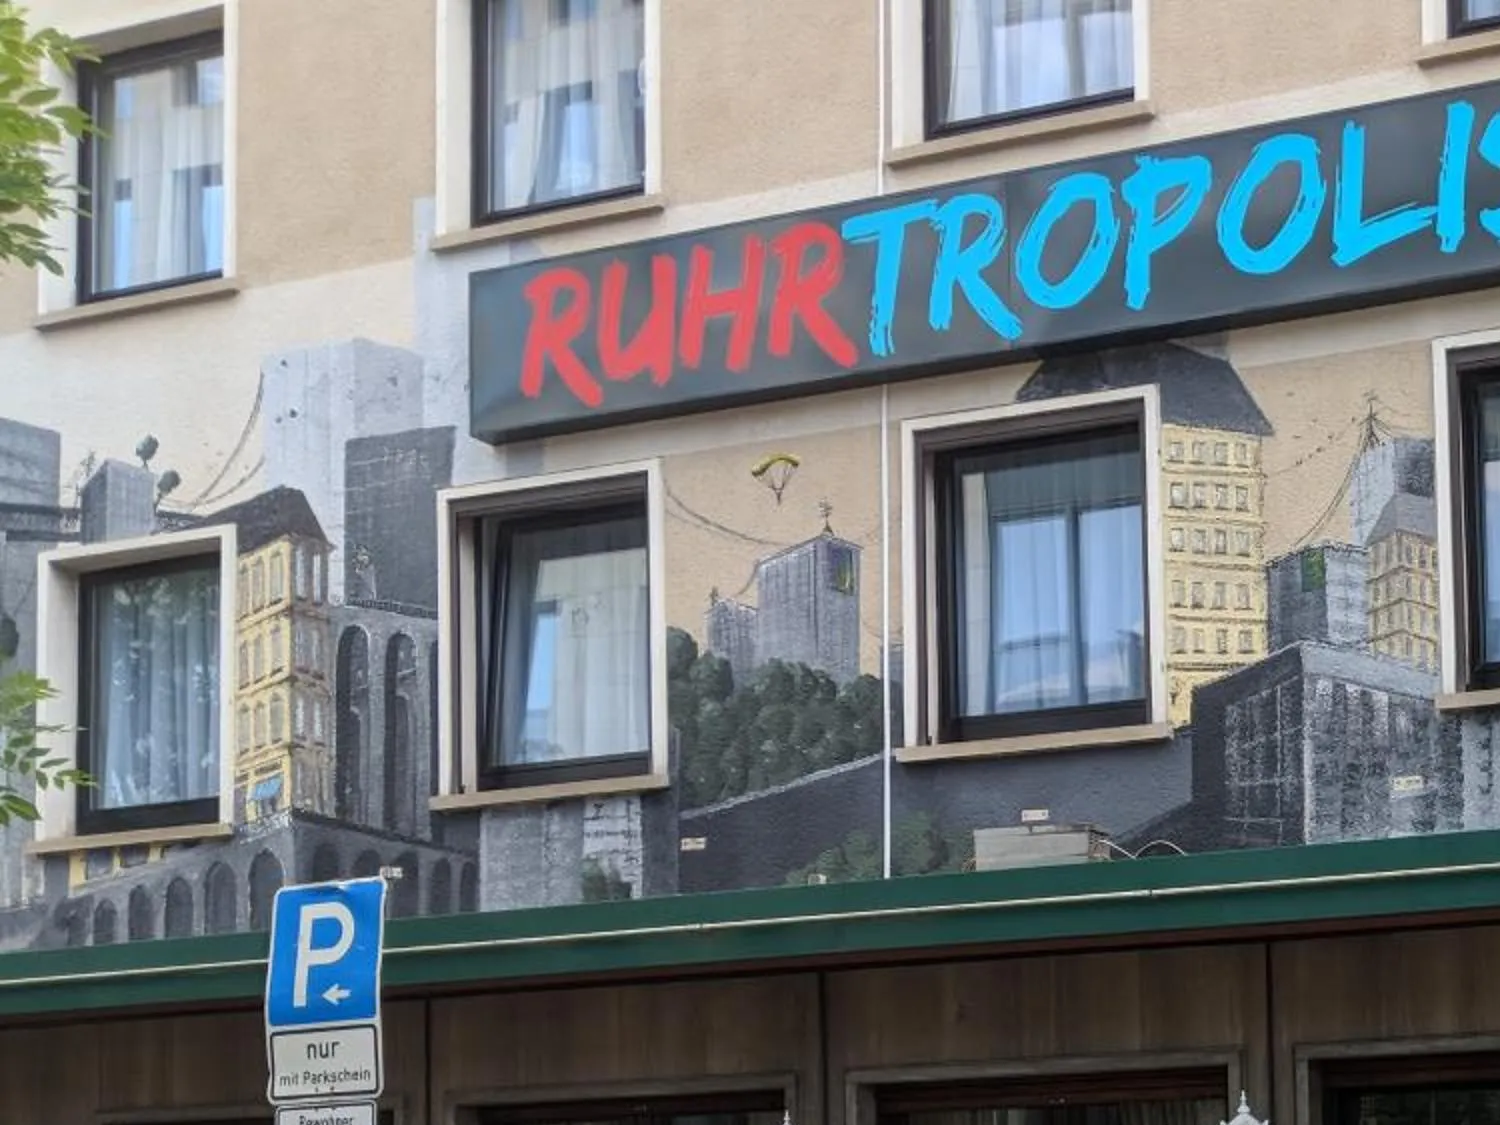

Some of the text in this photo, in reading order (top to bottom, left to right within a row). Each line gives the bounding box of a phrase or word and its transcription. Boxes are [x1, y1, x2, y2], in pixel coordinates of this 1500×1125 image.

[293, 901, 355, 1007] P
[306, 1040, 341, 1060] nur
[279, 1067, 371, 1087] mit Parkschein
